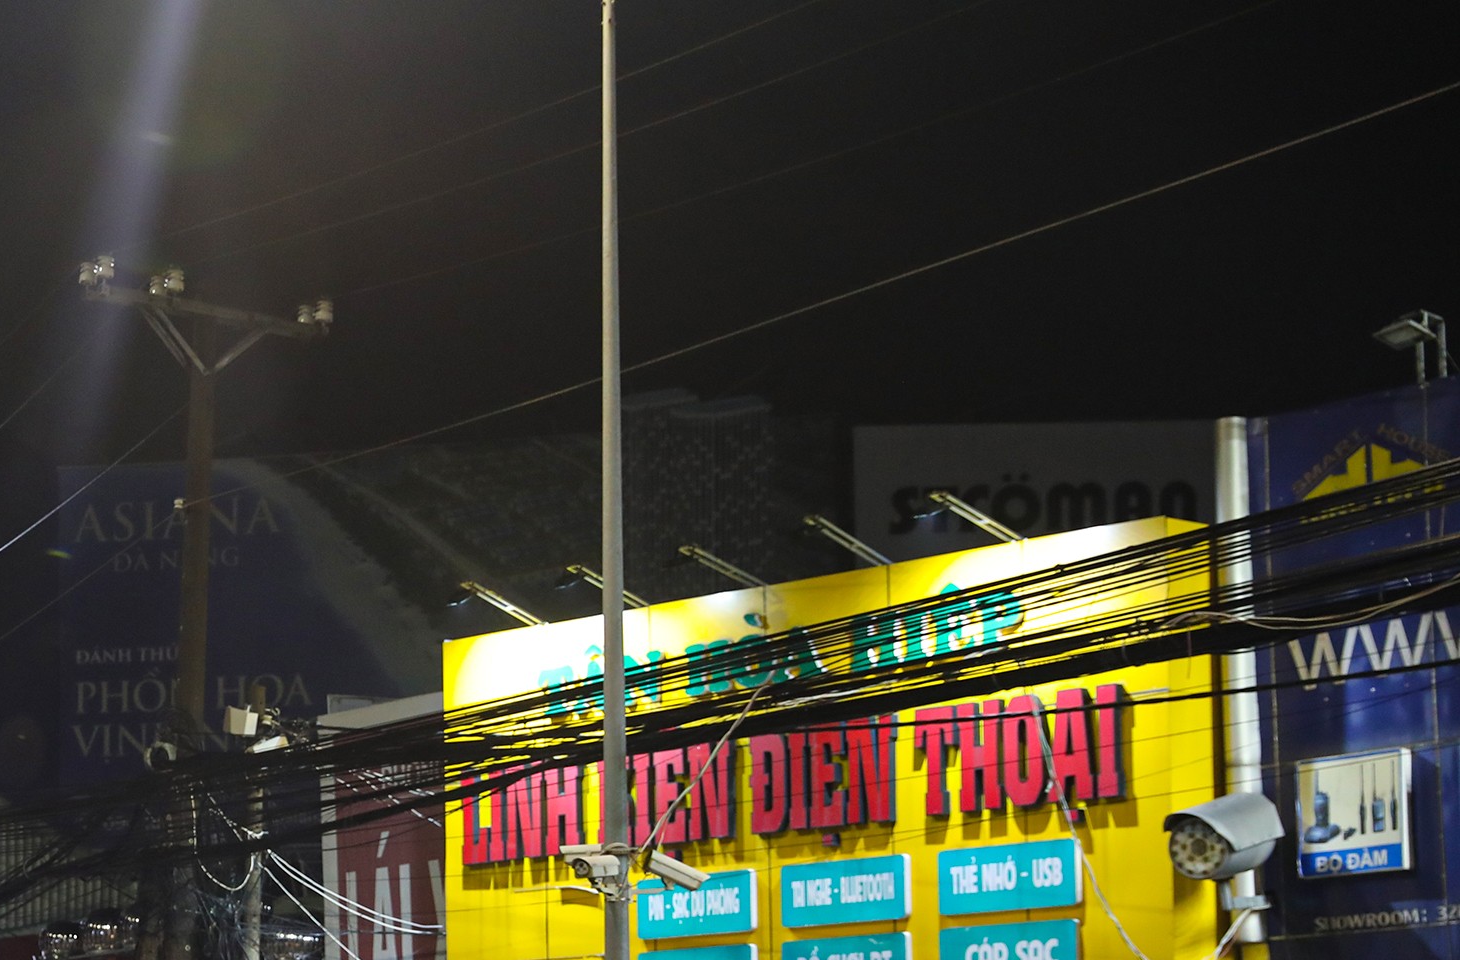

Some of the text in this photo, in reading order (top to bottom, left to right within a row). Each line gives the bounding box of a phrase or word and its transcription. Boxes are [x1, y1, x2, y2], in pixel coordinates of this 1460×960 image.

[160, 547, 239, 568] NNG
[914, 684, 1128, 823] THOẠI
[950, 855, 979, 894] THẺ
[1032, 857, 1063, 888] USB
[1314, 851, 1343, 874] BỘ
[1314, 908, 1428, 932] SHOWROOM:
